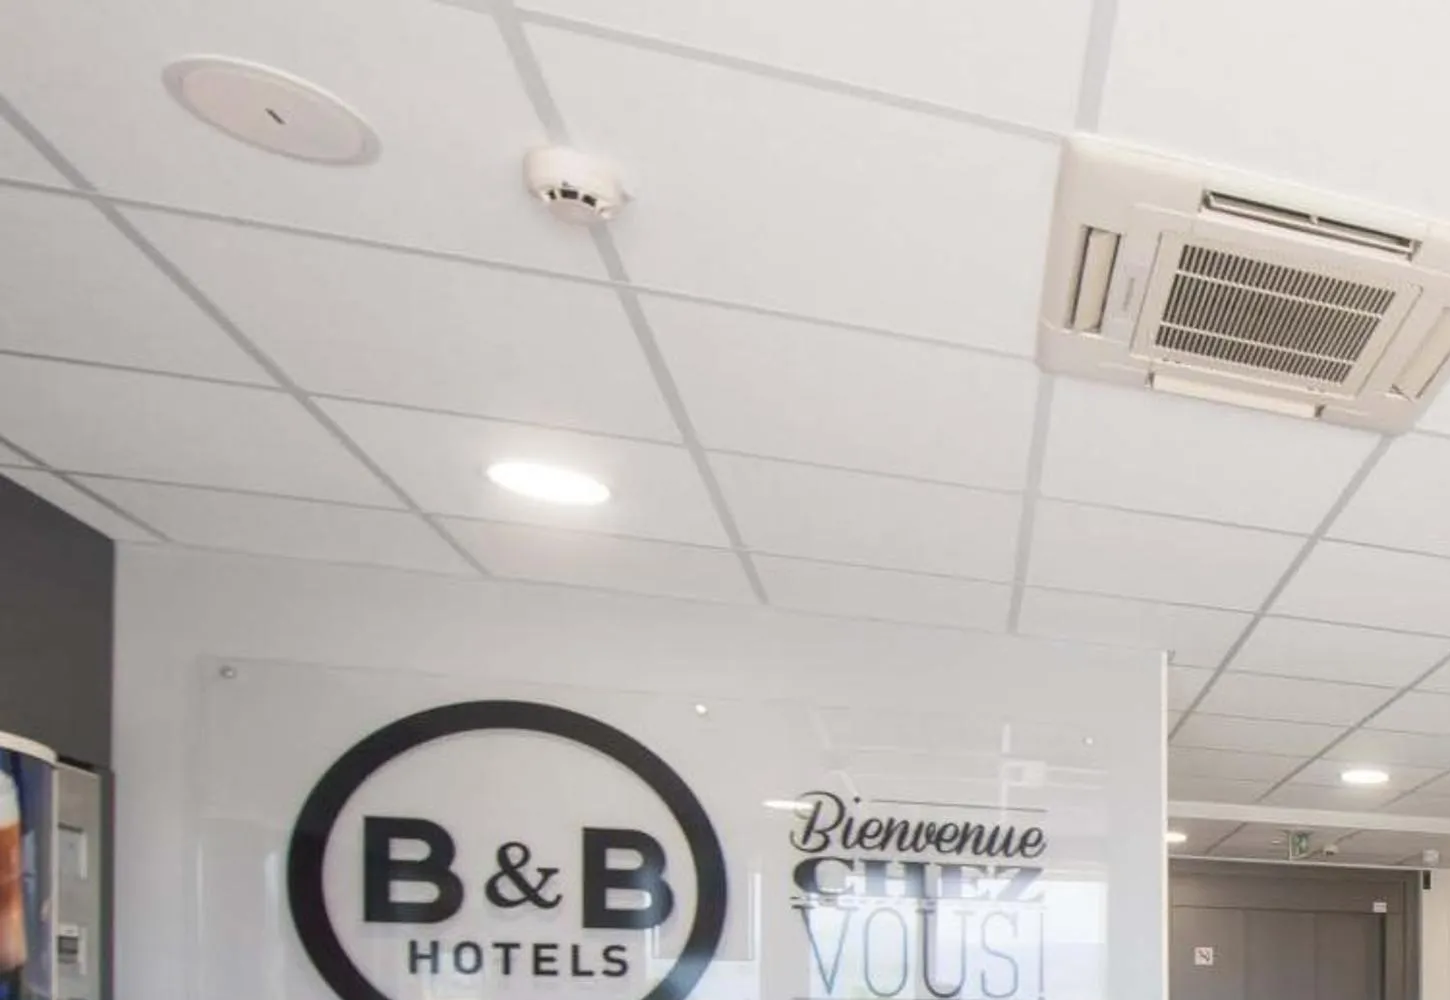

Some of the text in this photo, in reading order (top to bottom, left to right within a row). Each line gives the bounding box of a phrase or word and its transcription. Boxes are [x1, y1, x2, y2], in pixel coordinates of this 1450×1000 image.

[790, 791, 1047, 859] Bienvenue
[362, 815, 674, 930] B&B
[791, 856, 1044, 903] CHEZ
[407, 939, 631, 979] HOTELS
